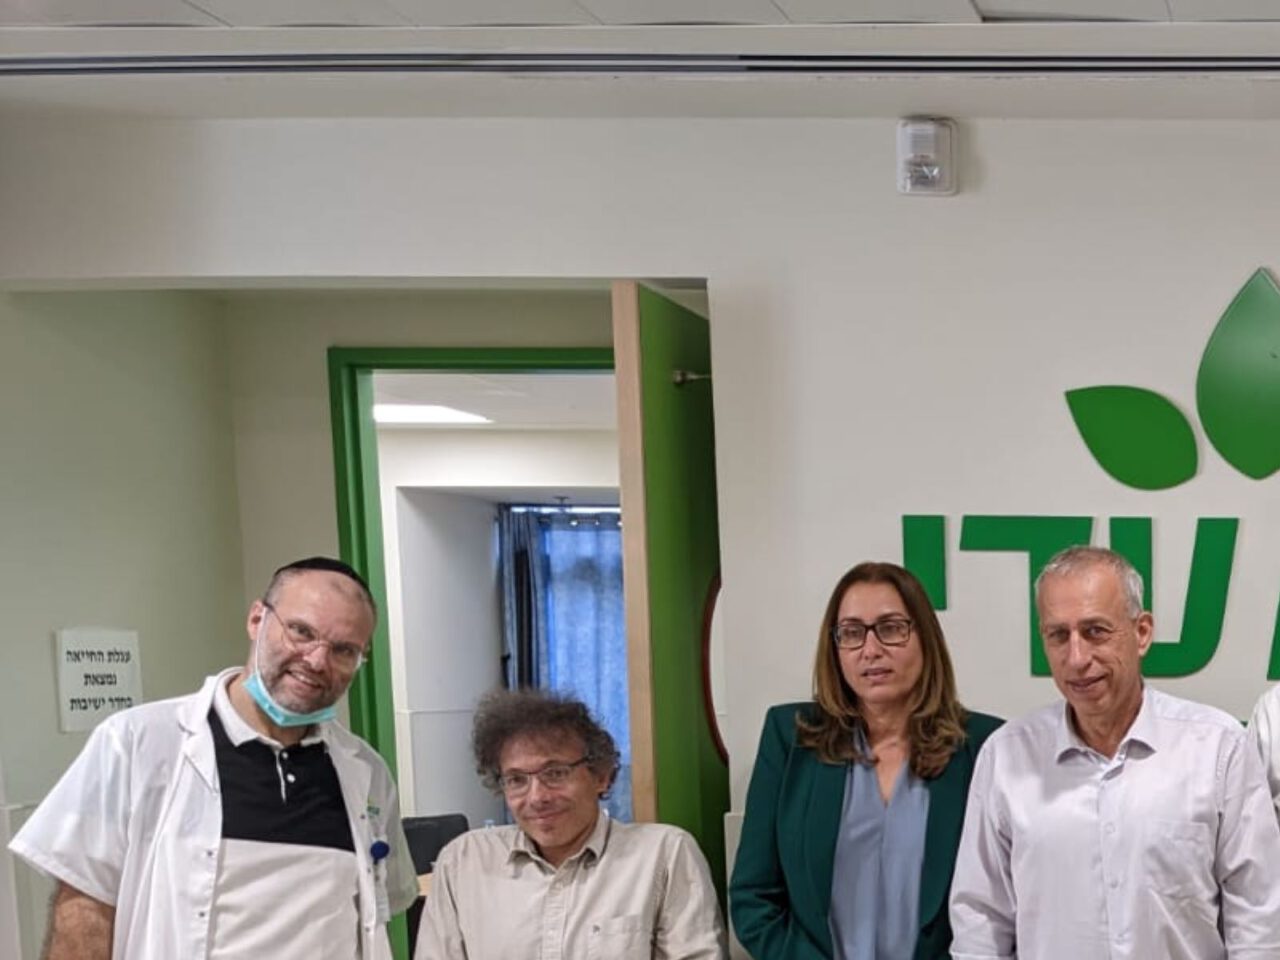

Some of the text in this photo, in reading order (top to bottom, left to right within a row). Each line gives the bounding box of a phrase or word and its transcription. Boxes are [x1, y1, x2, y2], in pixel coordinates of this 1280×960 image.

[66, 648, 131, 663] עגלת החייאה
[83, 673, 117, 686] נמצאת
[70, 698, 106, 711] ישיבות
